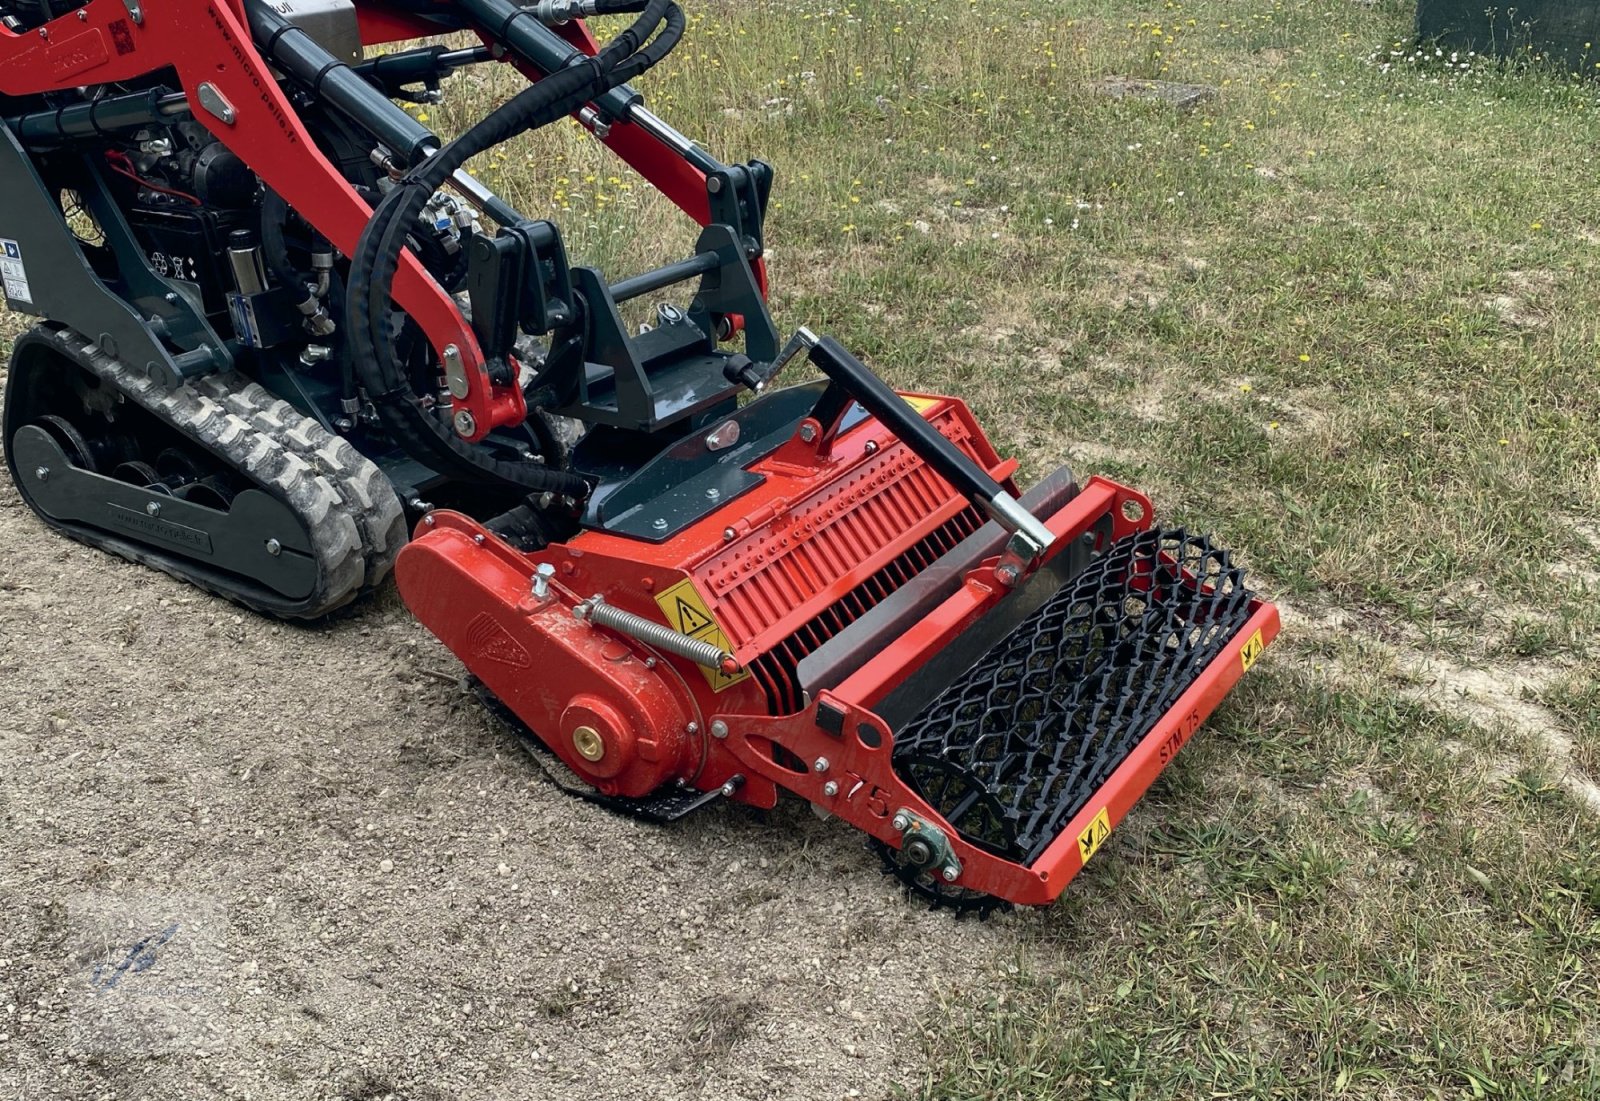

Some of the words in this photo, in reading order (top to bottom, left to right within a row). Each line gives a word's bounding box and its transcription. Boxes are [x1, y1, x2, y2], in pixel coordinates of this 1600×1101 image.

[207, 6, 298, 143] www.micro-pelle.fr
[1159, 727, 1183, 764] STM
[1186, 708, 1199, 733] 75
[845, 769, 892, 819] 75
